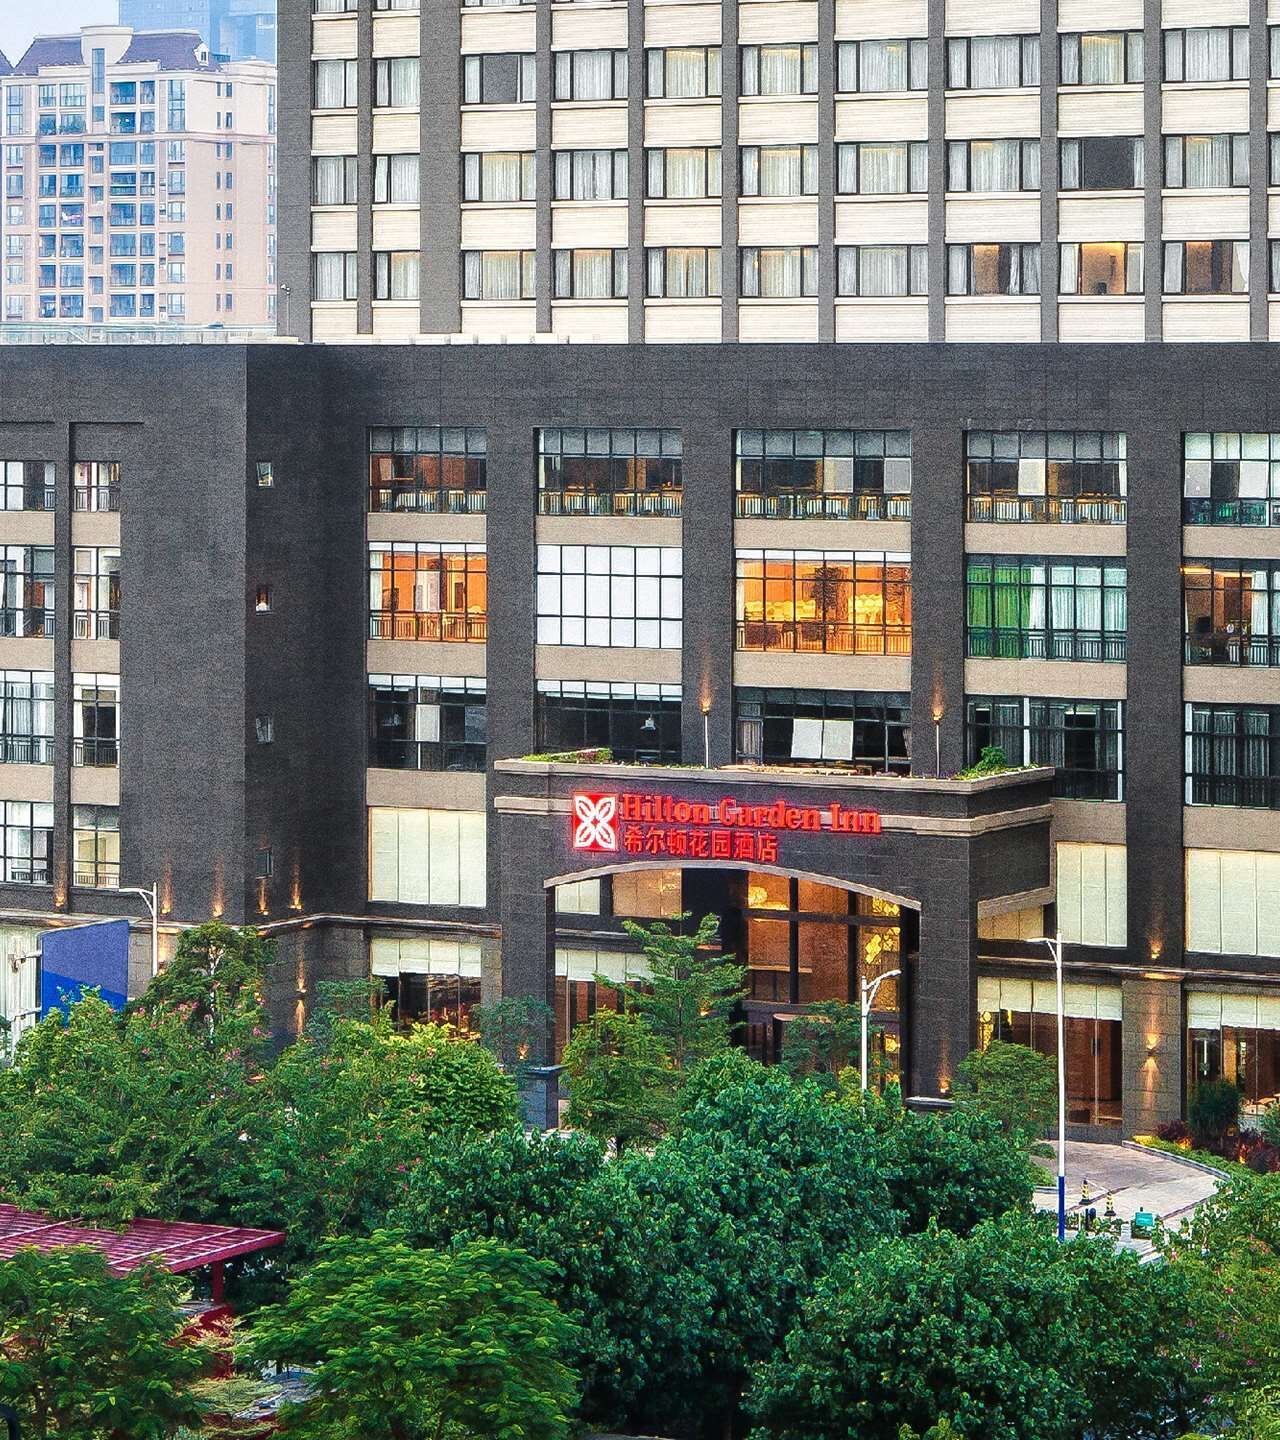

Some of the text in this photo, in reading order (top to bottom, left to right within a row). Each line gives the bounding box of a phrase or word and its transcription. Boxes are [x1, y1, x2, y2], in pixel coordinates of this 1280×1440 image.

[622, 792, 882, 835] Hilton Garden Inn
[623, 825, 780, 863] 希尔顿花园酒店
